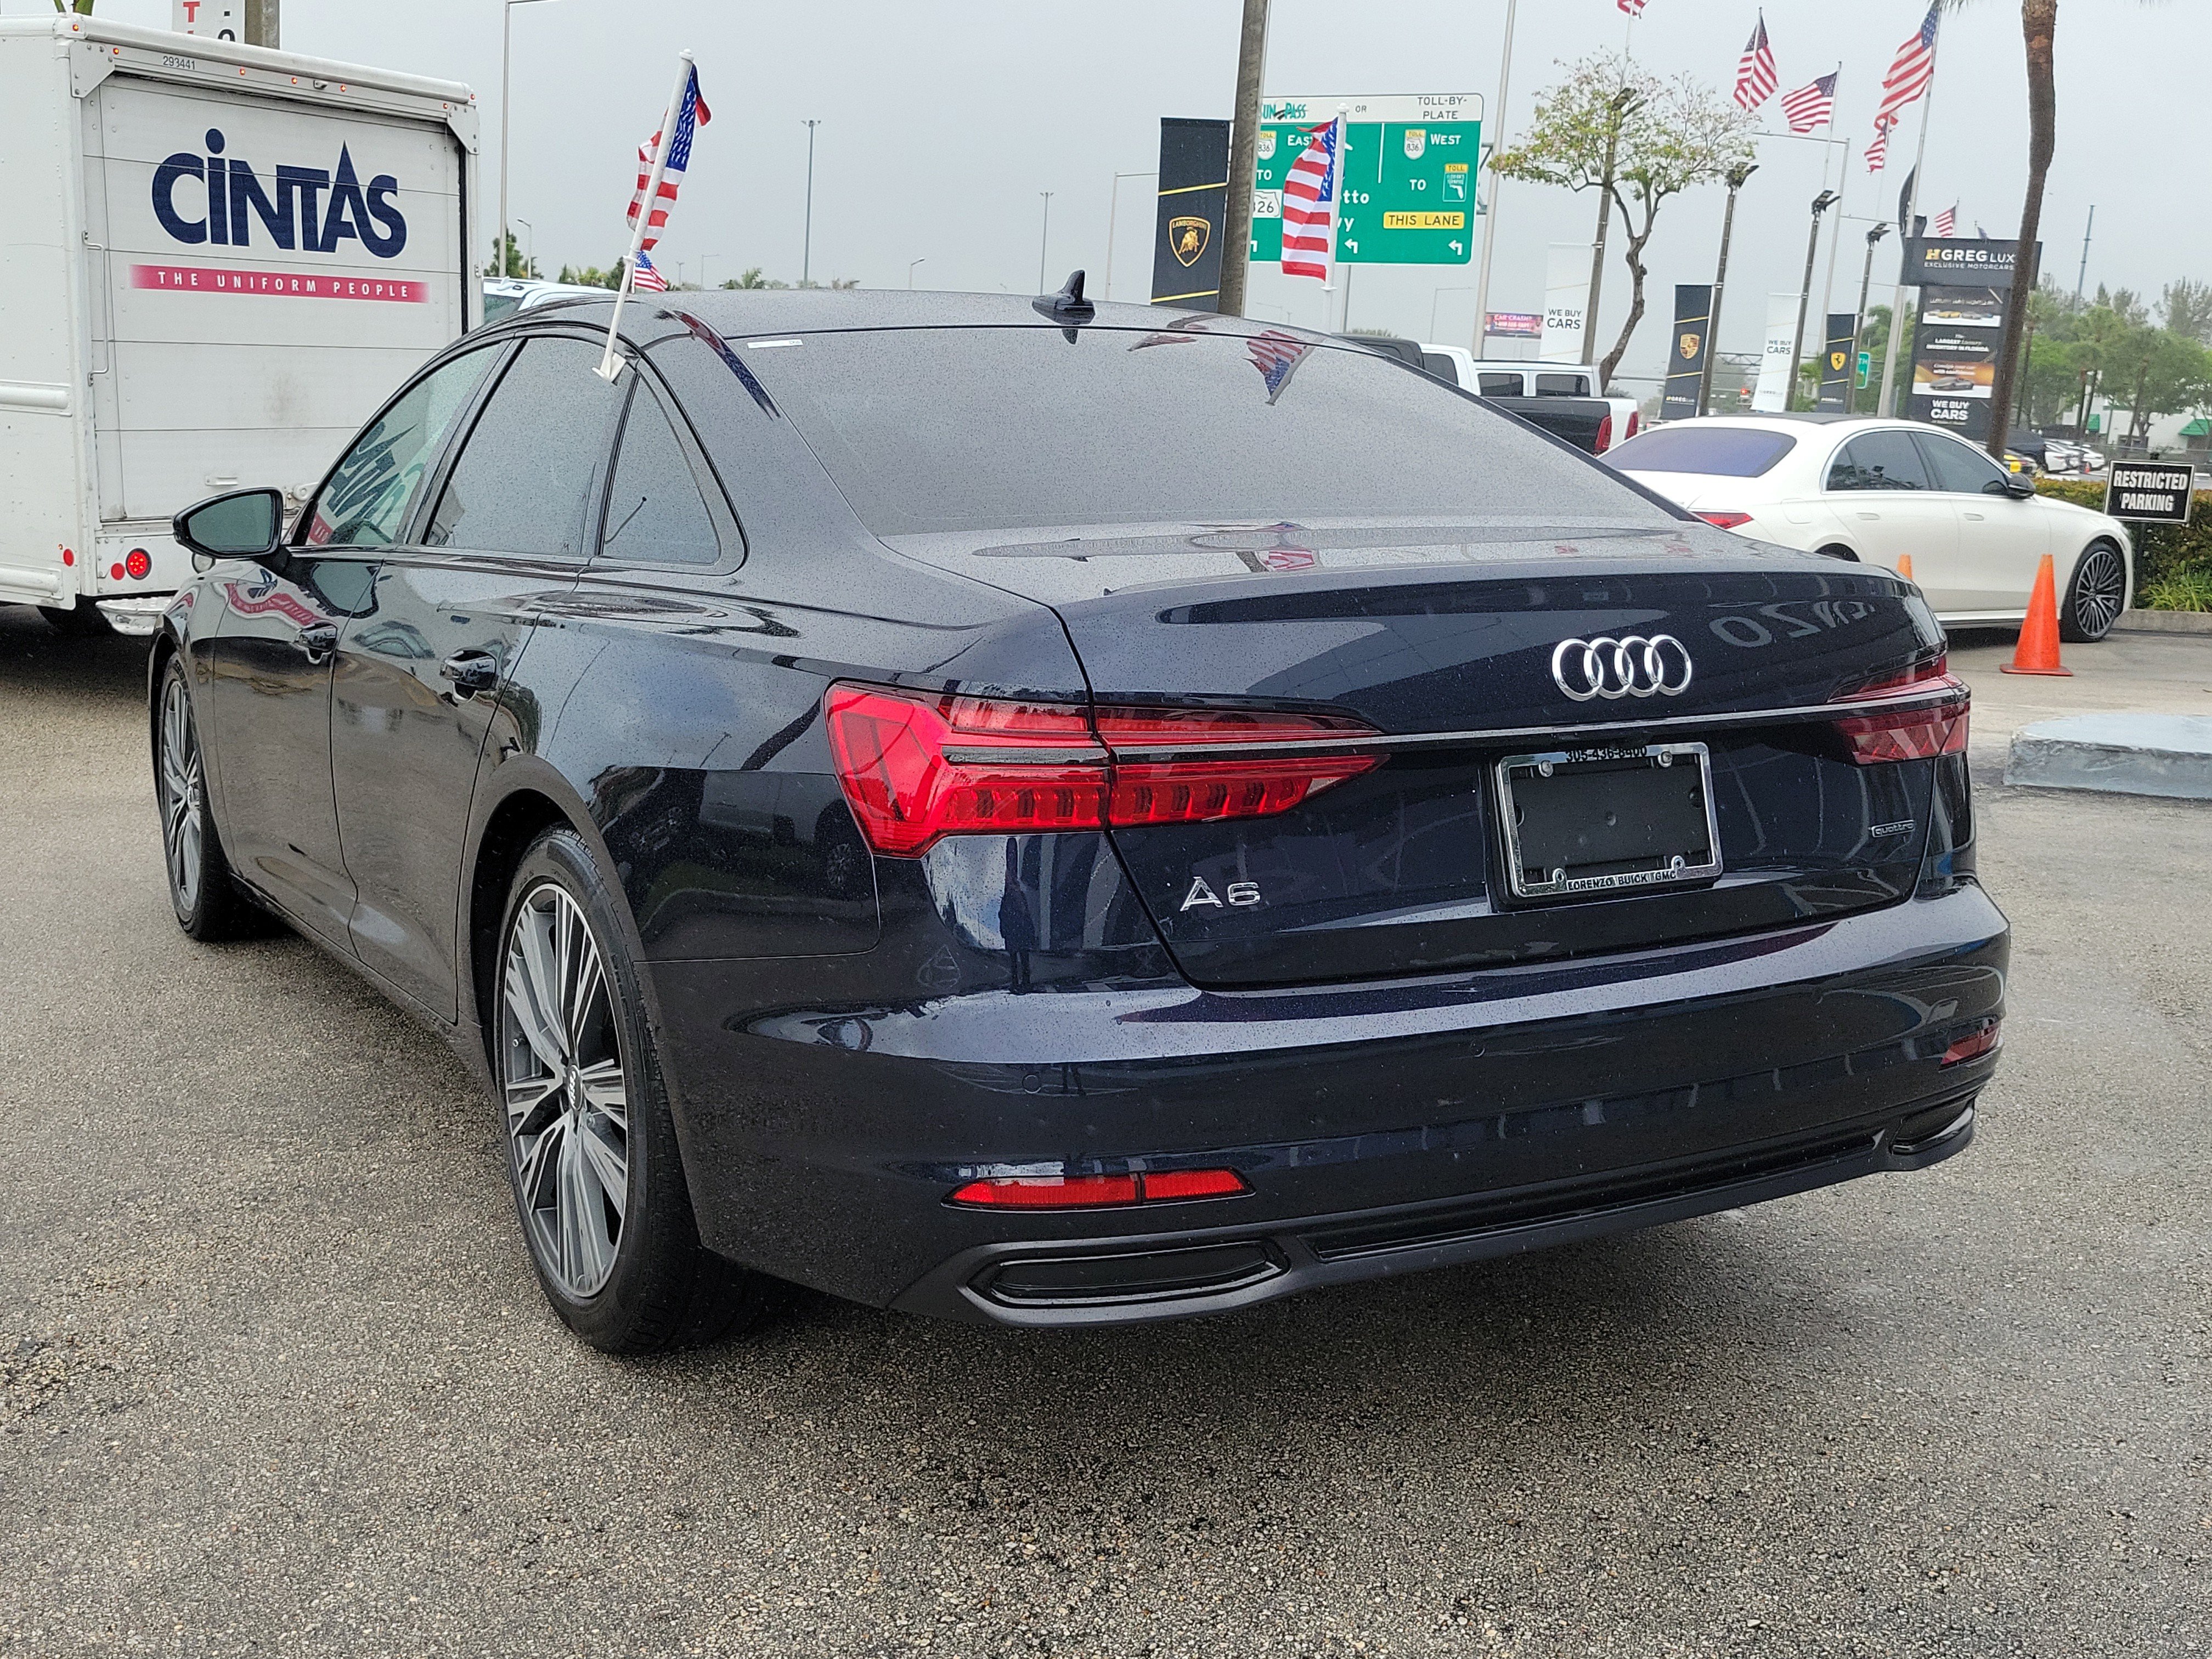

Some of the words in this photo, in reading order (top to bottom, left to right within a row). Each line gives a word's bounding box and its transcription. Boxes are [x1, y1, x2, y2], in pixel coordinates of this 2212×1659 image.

[163, 55, 195, 70] 293441
[1263, 104, 1276, 119] UN
[1423, 111, 1458, 119] PLATE
[1430, 133, 1462, 145] WEST
[1406, 143, 1419, 151] 836
[1256, 170, 1272, 180] TO
[1409, 179, 1426, 190] TO
[1389, 215, 1417, 225] THIS
[1425, 215, 1460, 225] LANE
[1990, 252, 2017, 263] LUX
[159, 272, 199, 286] THE
[218, 275, 316, 292] UNIFORM
[334, 282, 408, 297] PEOPLE
[1547, 318, 1581, 329] CARS
[1767, 346, 1791, 354] CARS
[1932, 399, 1948, 408] WE
[1949, 400, 1971, 409] BUY
[1930, 408, 1969, 420] CARS
[2113, 470, 2188, 490] RESTRICTED
[2120, 493, 2174, 511] PARKING
[1565, 746, 1647, 761] 305-436-8400
[1875, 823, 1914, 836] quattro
[1568, 876, 1612, 891] LORENZO
[1618, 873, 1648, 885] BUICK
[1655, 870, 1677, 881] GMC
[1180, 876, 1261, 911] A6
